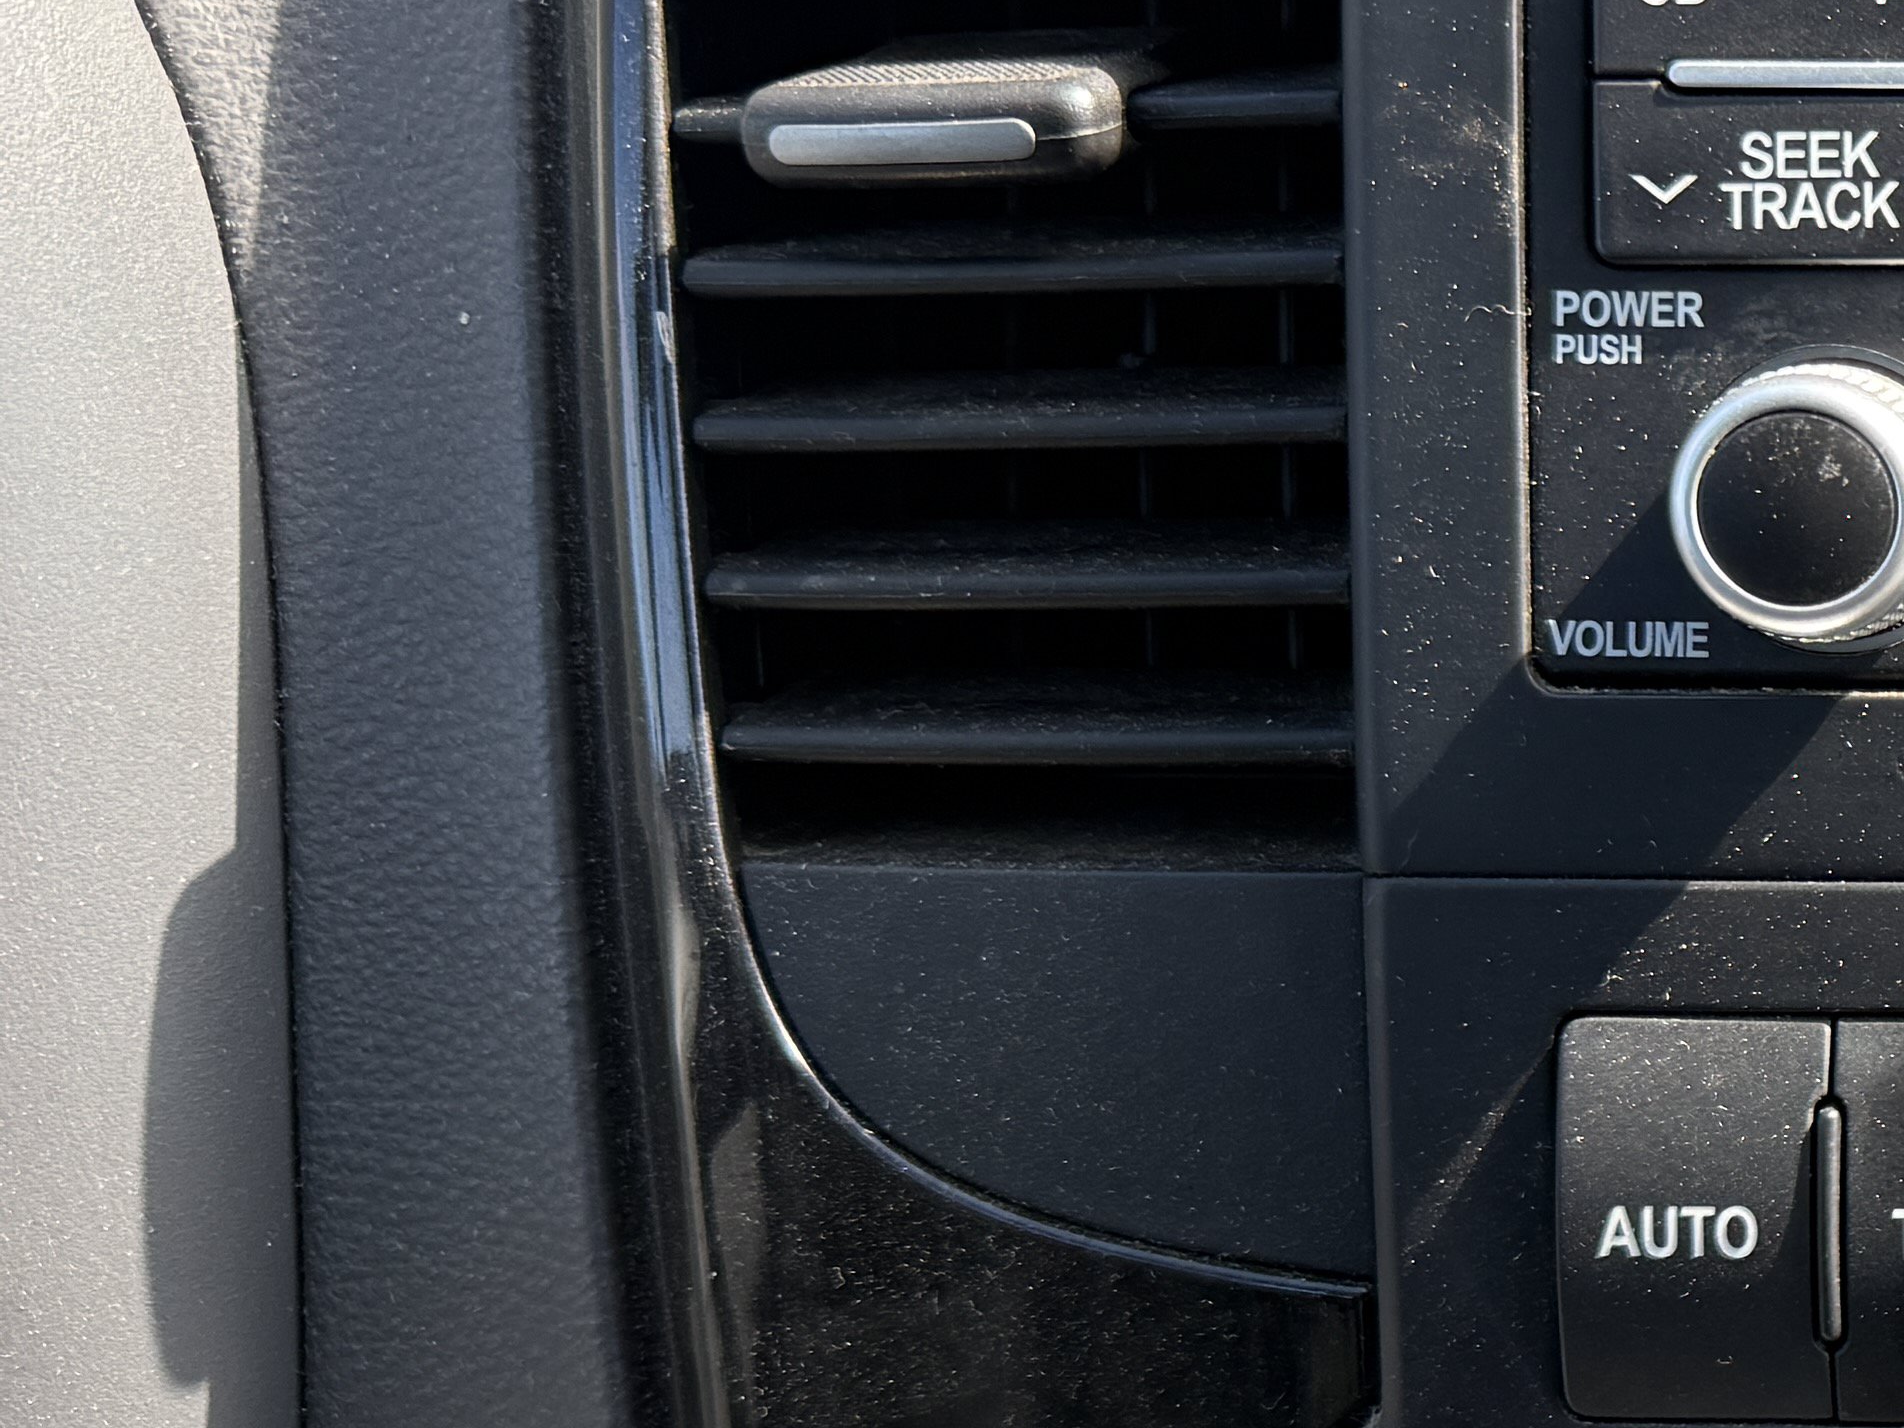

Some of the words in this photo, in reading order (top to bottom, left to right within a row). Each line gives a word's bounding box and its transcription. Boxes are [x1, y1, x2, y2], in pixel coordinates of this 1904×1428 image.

[1740, 130, 1880, 180] SEEK
[1720, 182, 1900, 231] TRACK
[1555, 290, 1705, 327] POWER
[1555, 333, 1643, 365] PUSH
[1549, 620, 1709, 658] VOLUME
[1596, 1205, 1758, 1259] AUTO
